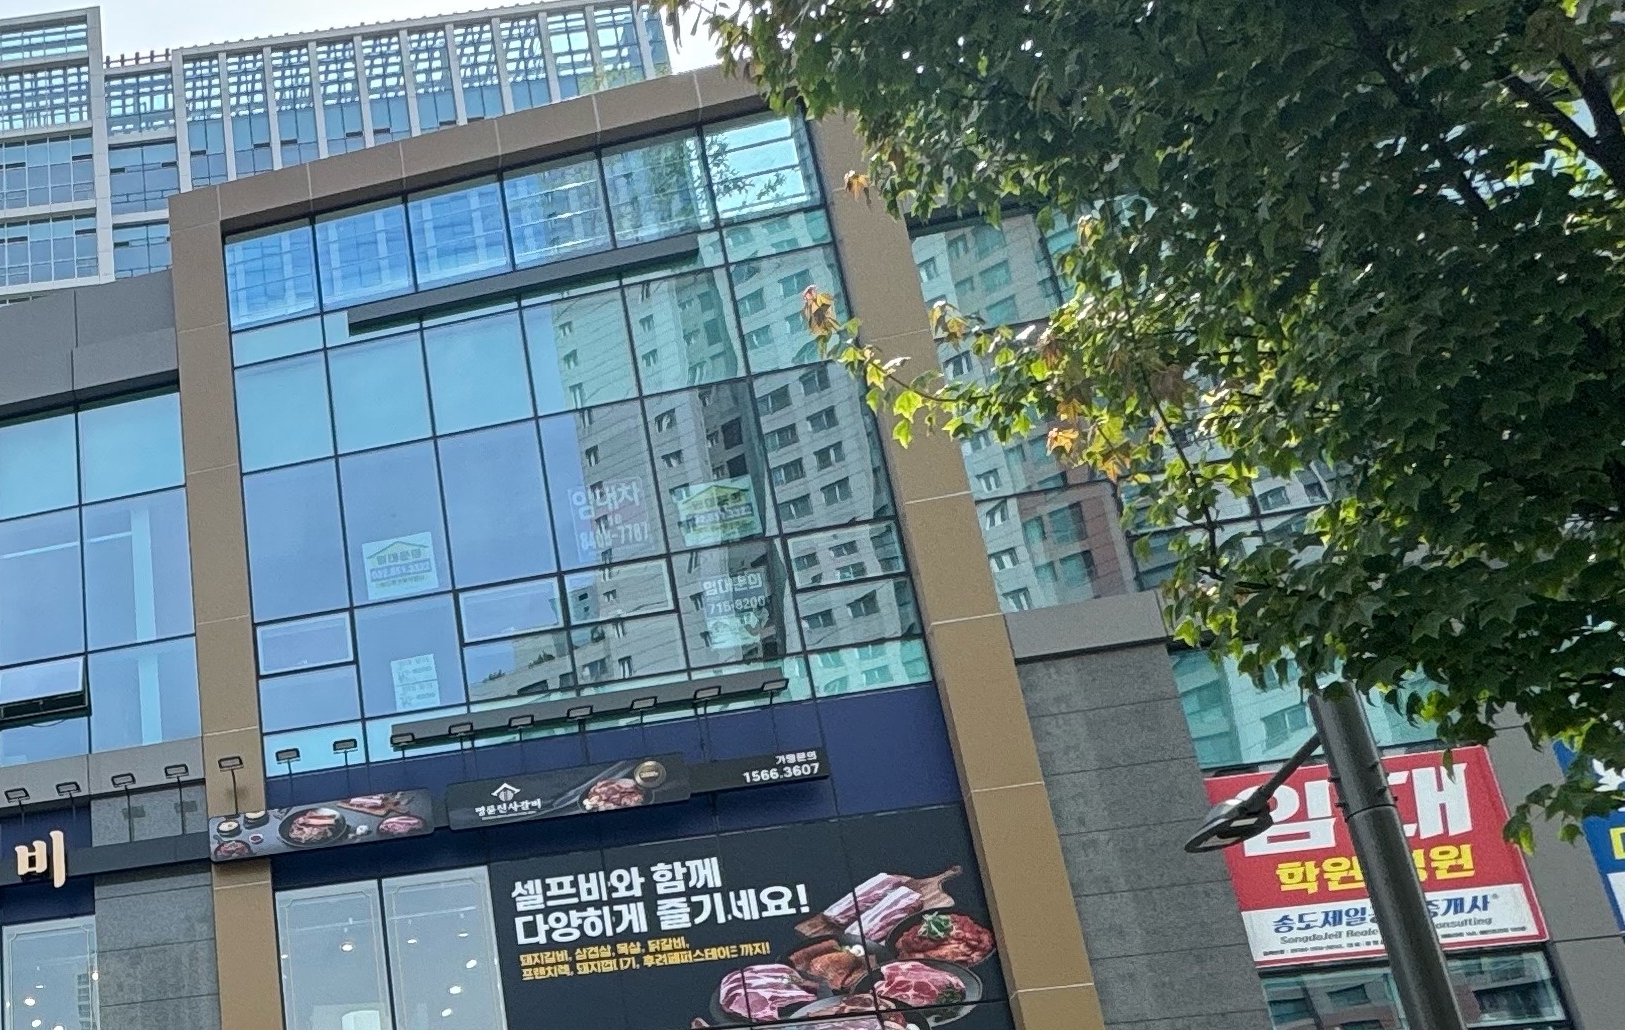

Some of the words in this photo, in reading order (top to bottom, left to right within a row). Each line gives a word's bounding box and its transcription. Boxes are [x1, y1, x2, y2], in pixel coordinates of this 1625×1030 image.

[741, 762, 821, 784] 1566.3607
[511, 866, 646, 912] 셀프비와
[651, 857, 723, 895] 함께
[514, 901, 649, 945] 다양하게
[656, 883, 811, 932] 즐기세요!
